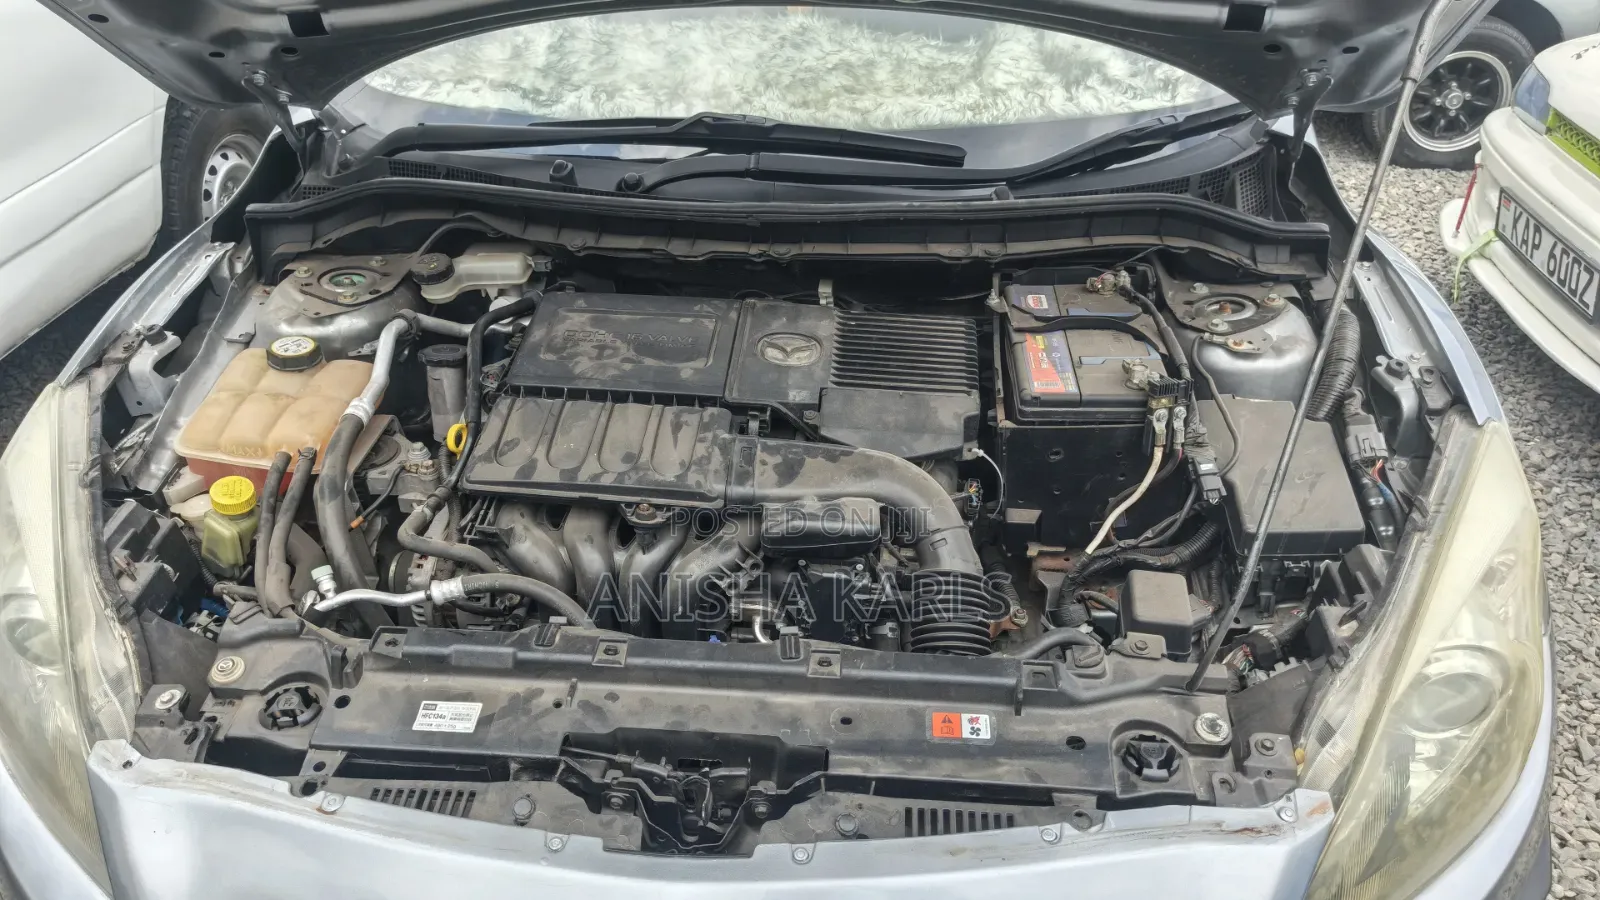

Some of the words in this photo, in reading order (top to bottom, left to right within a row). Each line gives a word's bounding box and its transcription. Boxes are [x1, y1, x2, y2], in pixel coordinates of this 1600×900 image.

[1511, 205, 1542, 260] KAP
[1546, 240, 1595, 311] 600Z
[420, 712, 447, 720] HFC134a
